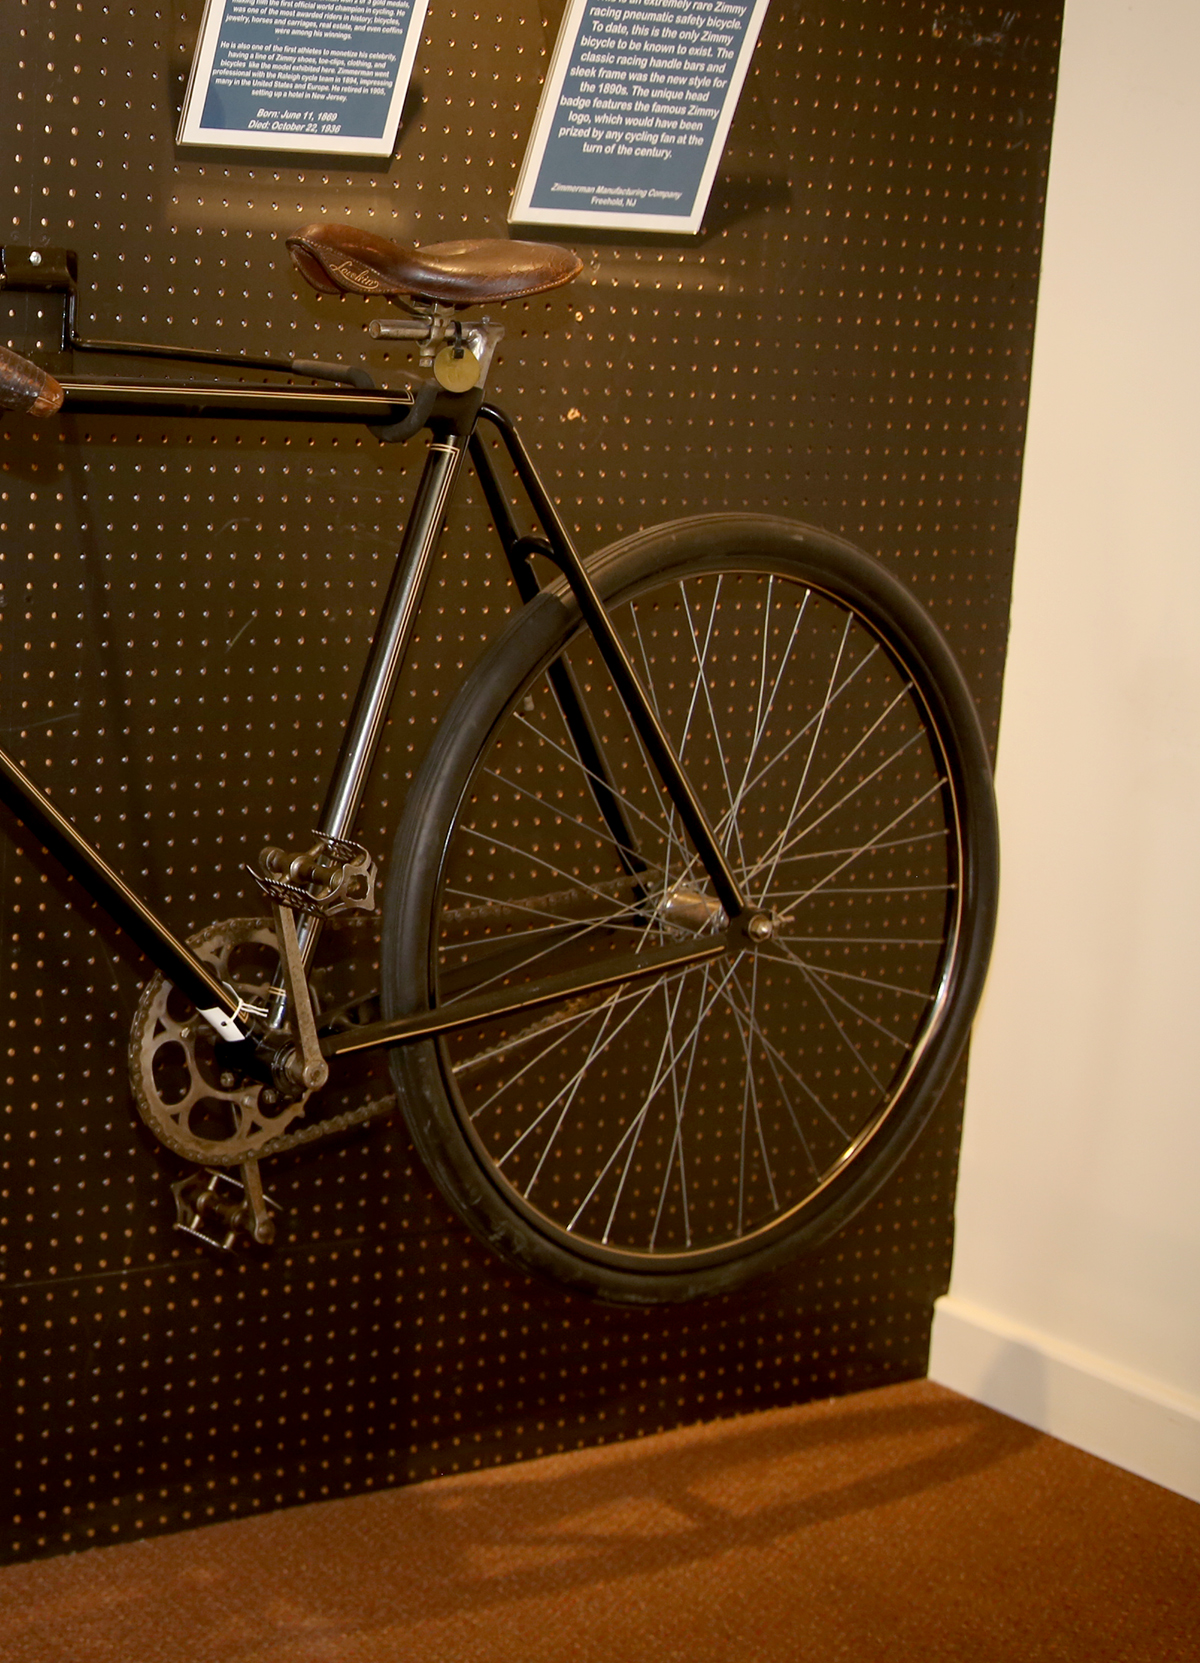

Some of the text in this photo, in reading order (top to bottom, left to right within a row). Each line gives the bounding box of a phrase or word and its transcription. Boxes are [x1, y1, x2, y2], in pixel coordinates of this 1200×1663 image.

[589, 6, 742, 31] racing pneumatic safety bicycle.
[692, 1, 713, 11] rare
[714, 3, 747, 17] Zimmy
[592, 21, 733, 46] To date, this is the only Zimmy
[581, 35, 735, 59] bicycle to be known to exist. The
[581, 51, 726, 73] classic racing handle bars and
[570, 66, 728, 89] sleek frame was the new style for
[580, 82, 710, 102] the 1890s. The unique head
[257, 109, 280, 118] Born:
[281, 110, 301, 120] June
[317, 112, 338, 122] 1869
[559, 95, 720, 120] badge features the famous Zimmy
[248, 120, 341, 133] Died: October 22, 1936
[568, 111, 703, 131] logo, which would have been
[558, 126, 704, 146] prized by any cycling fan at the
[582, 142, 672, 161] turn of the century.
[551, 182, 682, 200] Zimmerman Manufacturing Company
[591, 196, 637, 208] Freehold, NJ
